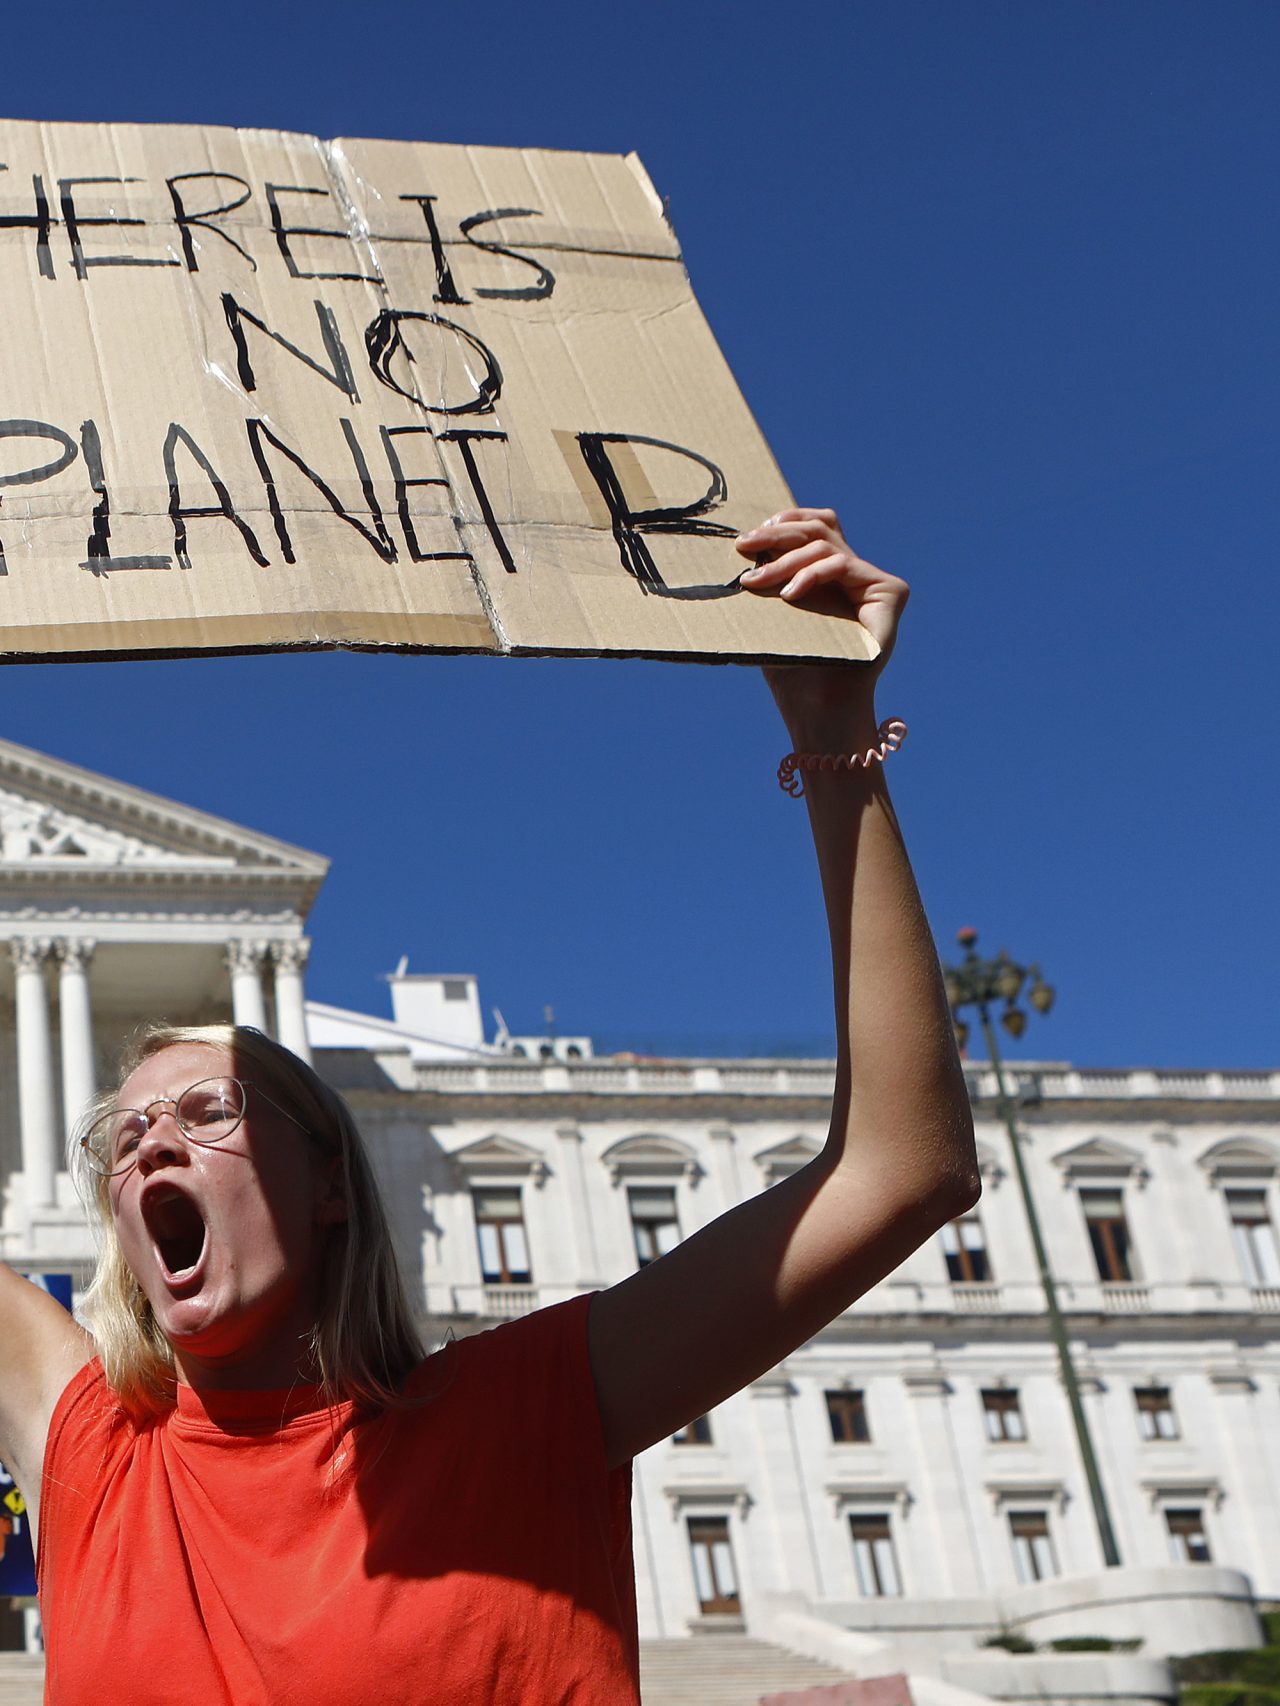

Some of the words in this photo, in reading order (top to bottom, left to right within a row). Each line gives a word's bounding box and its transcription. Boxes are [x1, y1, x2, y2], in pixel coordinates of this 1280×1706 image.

[399, 194, 555, 305] IS
[220, 292, 503, 415] NO
[575, 432, 772, 600] B
